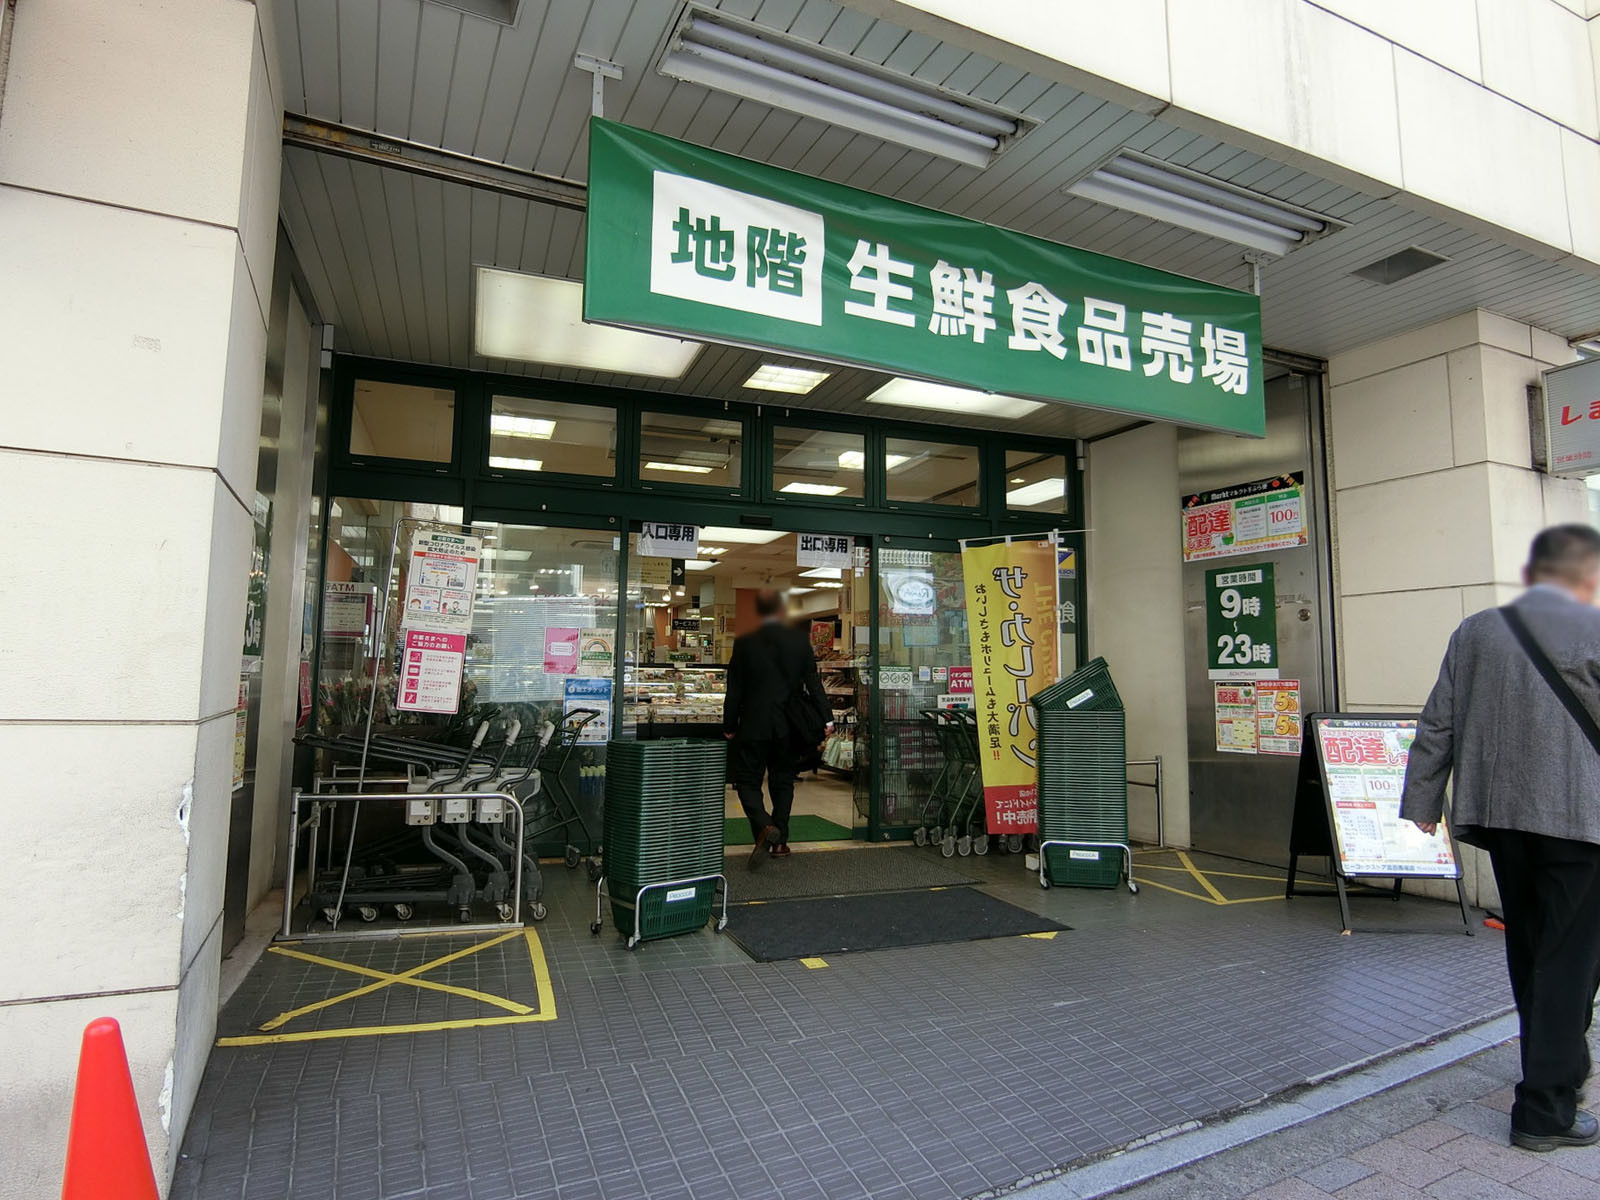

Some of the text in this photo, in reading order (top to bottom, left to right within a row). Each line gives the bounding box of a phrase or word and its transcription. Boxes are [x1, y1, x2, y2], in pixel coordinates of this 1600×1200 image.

[671, 207, 1250, 395] 地階 生鮮食品売場
[642, 524, 695, 542] 入口専用
[1188, 509, 1231, 537] 配達
[800, 535, 848, 553] 出口専用
[1221, 572, 1257, 584] 営業時間
[1220, 589, 1260, 619] 9時
[1217, 634, 1271, 665] 23時
[951, 680, 972, 688] ATM
